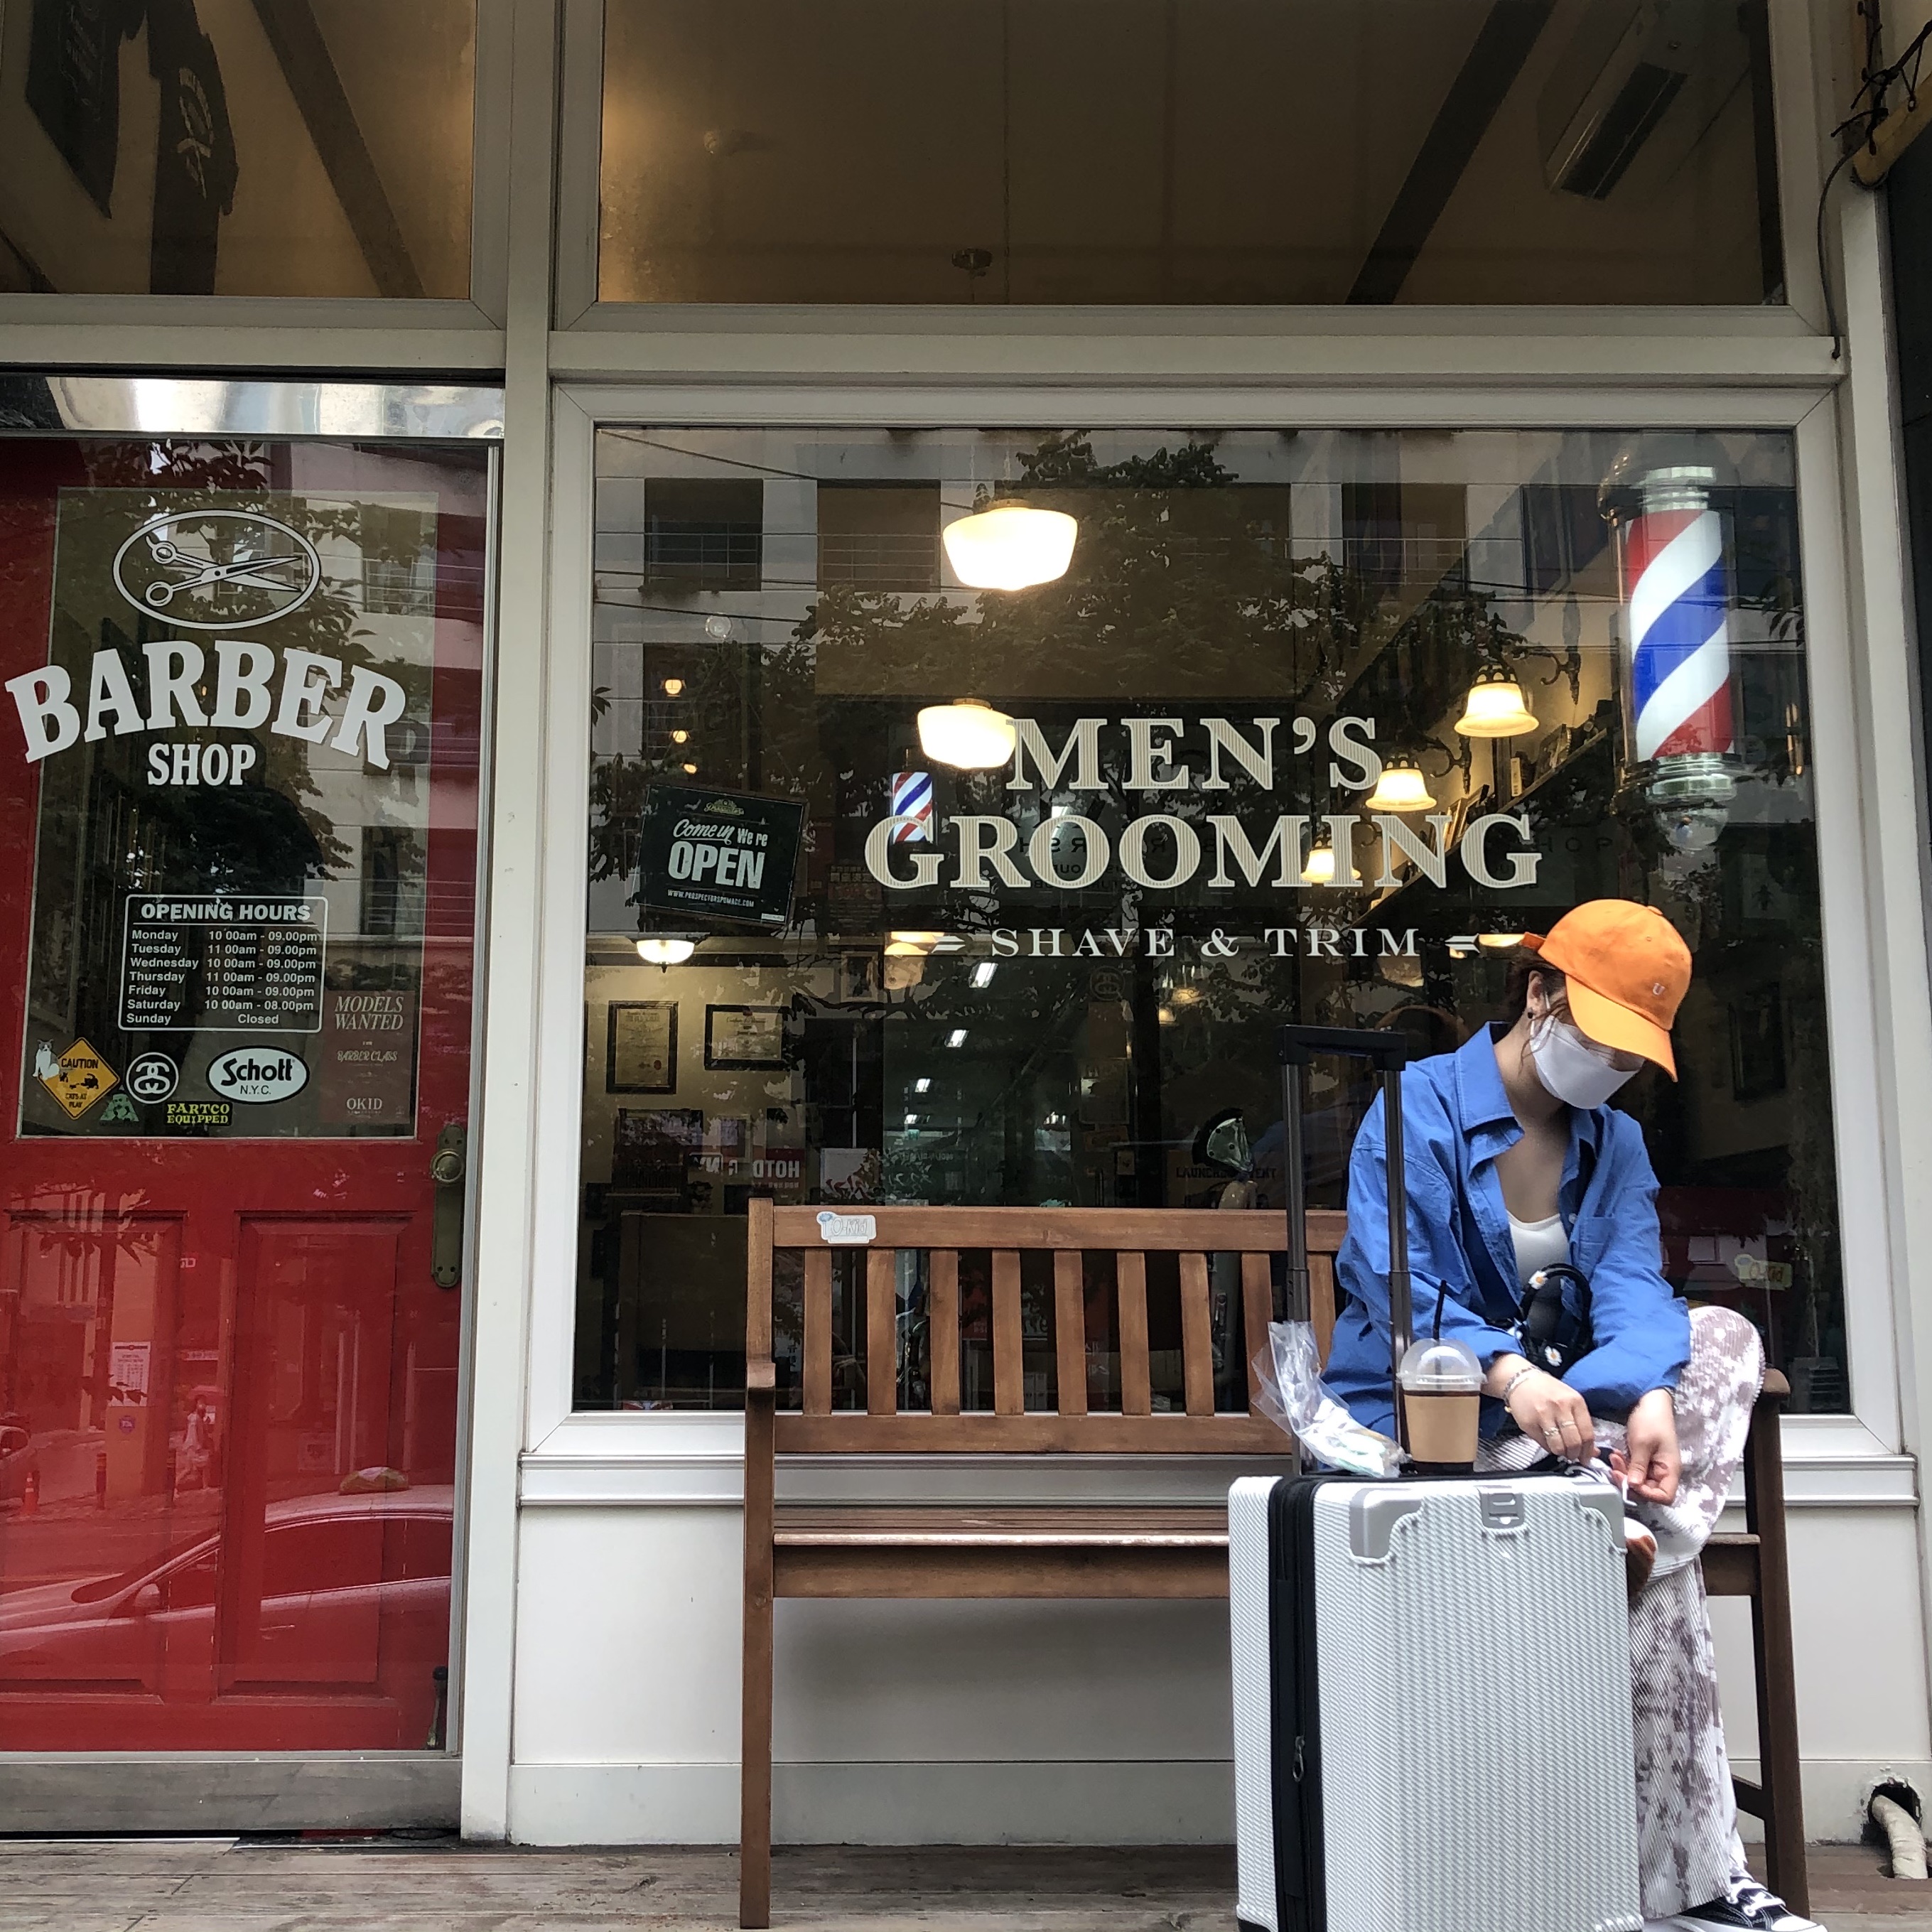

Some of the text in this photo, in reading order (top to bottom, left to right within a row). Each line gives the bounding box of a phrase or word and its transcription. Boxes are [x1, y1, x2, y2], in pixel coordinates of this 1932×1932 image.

[5, 639, 406, 770] BARBER
[1003, 716, 1383, 792] MEN'S
[147, 743, 257, 786] SHOP
[673, 819, 717, 838] Come
[716, 825, 735, 845] in
[864, 813, 1543, 890] GROOMING
[668, 841, 766, 890] OPEN
[141, 903, 311, 921] OPENING HOURS
[131, 930, 178, 941] Monday
[268, 932, 318, 943] 09.00pm
[991, 927, 1420, 957] SHAVE & TRIM
[131, 944, 181, 955] Tuesday
[267, 945, 317, 956] 09.00pm
[130, 957, 199, 969] Wednesday
[266, 959, 316, 971] 09.00pm
[129, 971, 185, 983] Thursday
[266, 973, 315, 984] 09.00pm
[129, 985, 166, 997] Friday
[265, 987, 314, 998] 09.00pm
[127, 999, 180, 1011] Saturday
[264, 1001, 313, 1012] 08.00pm
[335, 995, 404, 1013] MODELS
[126, 1013, 279, 1025] Sunday Closed
[335, 1014, 404, 1030] WANTED
[61, 1058, 99, 1068] CAUTION
[220, 1057, 293, 1086] Schott
[167, 1103, 230, 1114] FARTCO
[347, 1098, 383, 1110] OKID
[167, 1115, 230, 1124] EQUIPPED
